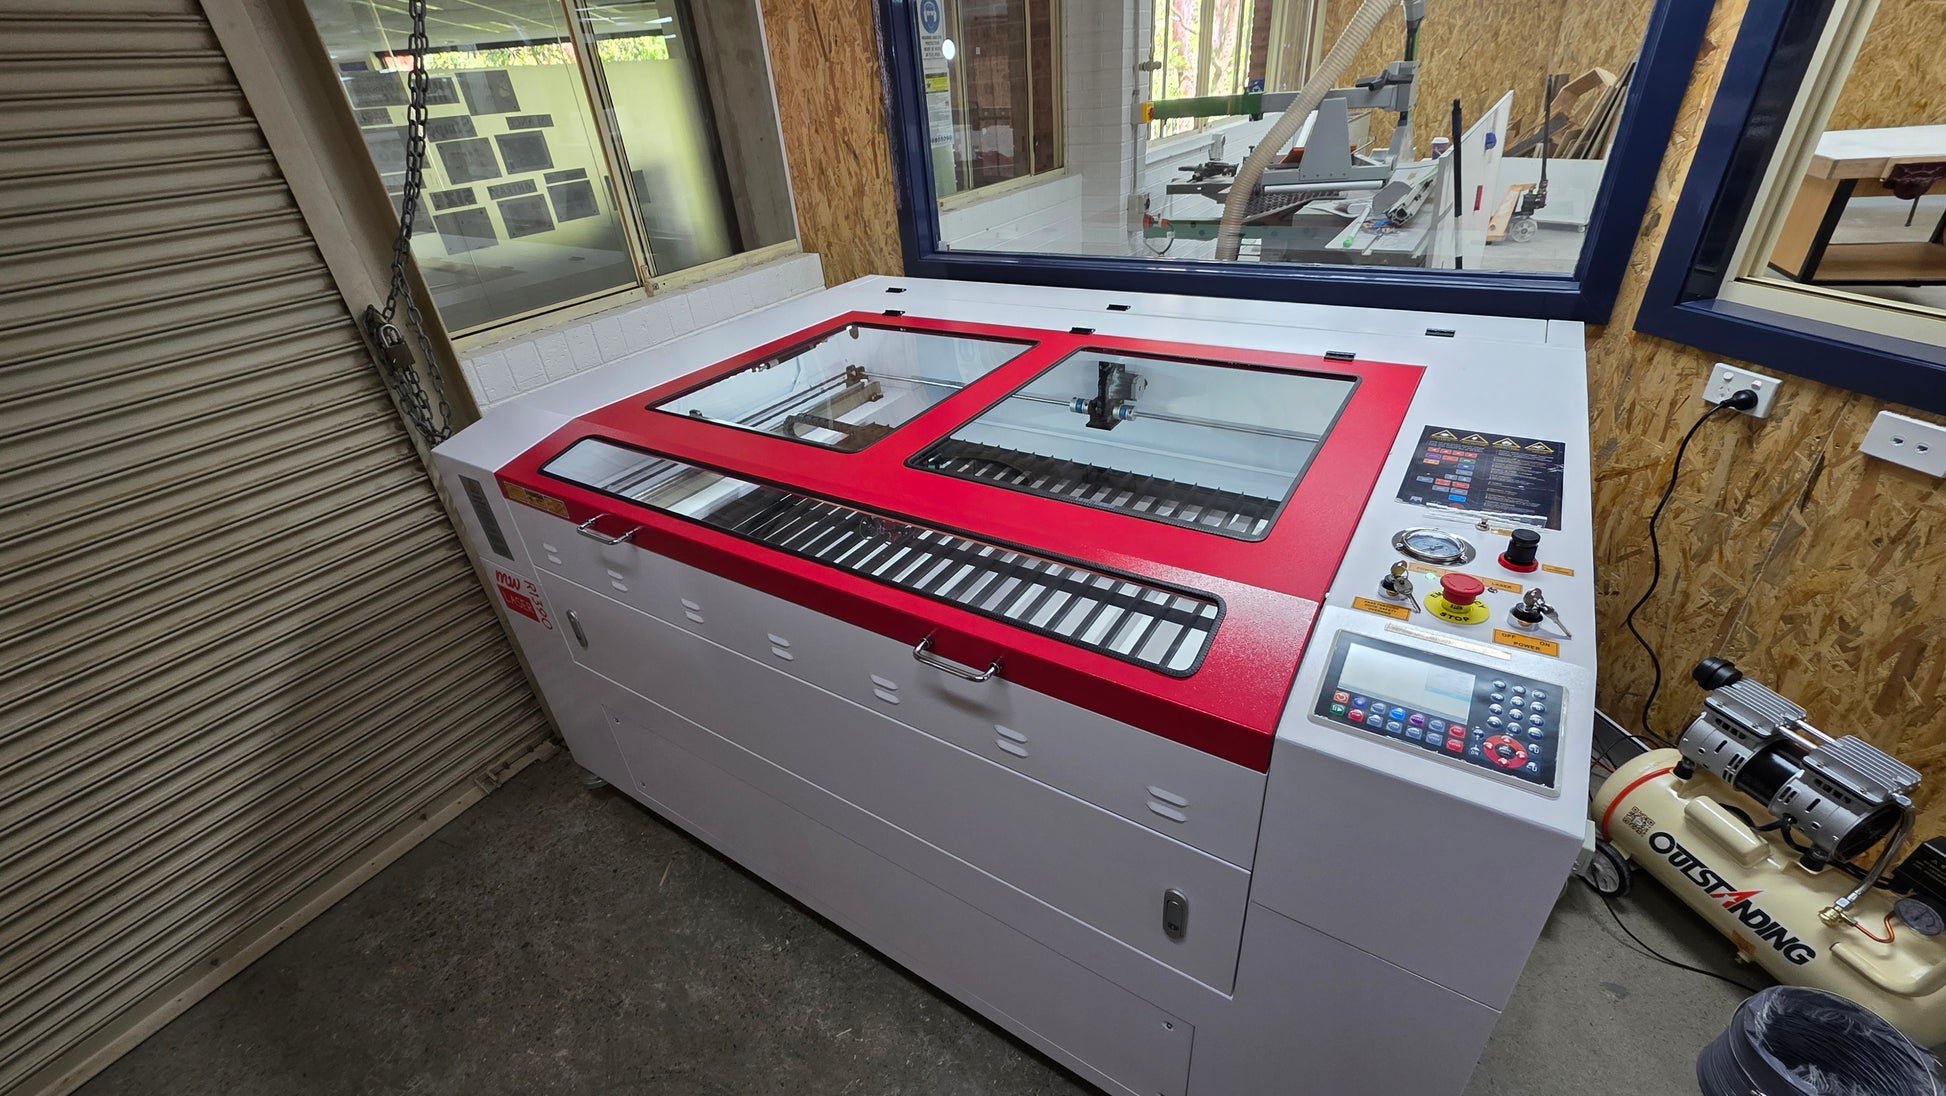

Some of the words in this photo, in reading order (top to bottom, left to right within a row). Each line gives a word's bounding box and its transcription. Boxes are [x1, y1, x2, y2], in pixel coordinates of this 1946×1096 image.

[1491, 581, 1512, 590] LASER
[502, 590, 532, 611] LASER
[524, 580, 553, 630] R1390
[1440, 612, 1470, 622] STOP
[1513, 641, 1541, 651] POWER
[1649, 832, 1816, 965] OUTSTANDING
